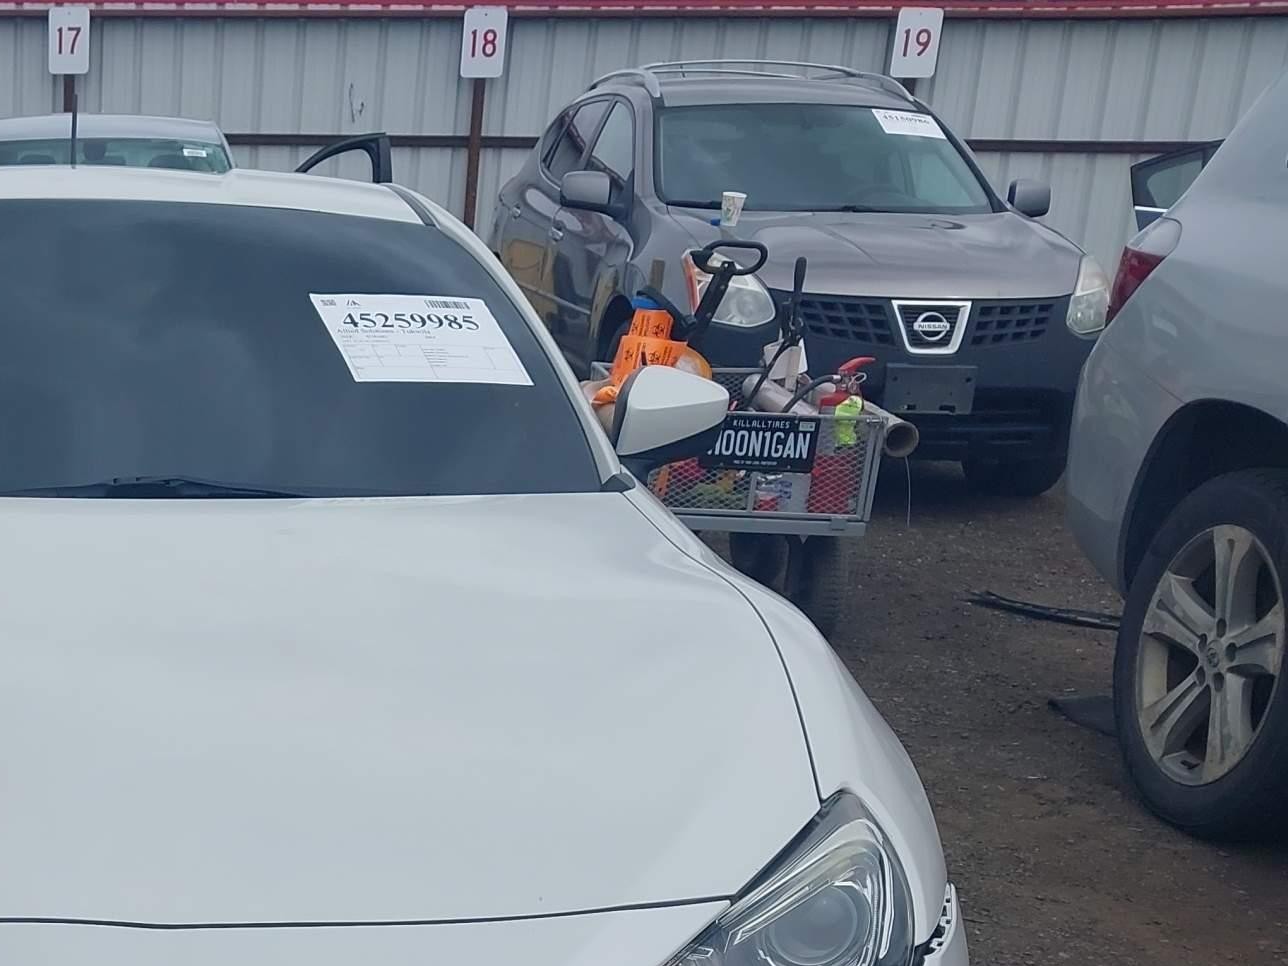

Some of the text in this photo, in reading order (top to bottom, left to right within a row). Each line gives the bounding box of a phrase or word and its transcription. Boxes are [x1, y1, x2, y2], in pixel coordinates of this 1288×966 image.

[57, 26, 82, 55] 17
[471, 28, 498, 58] 18
[902, 28, 932, 57] 19
[343, 313, 479, 331] 45259985
